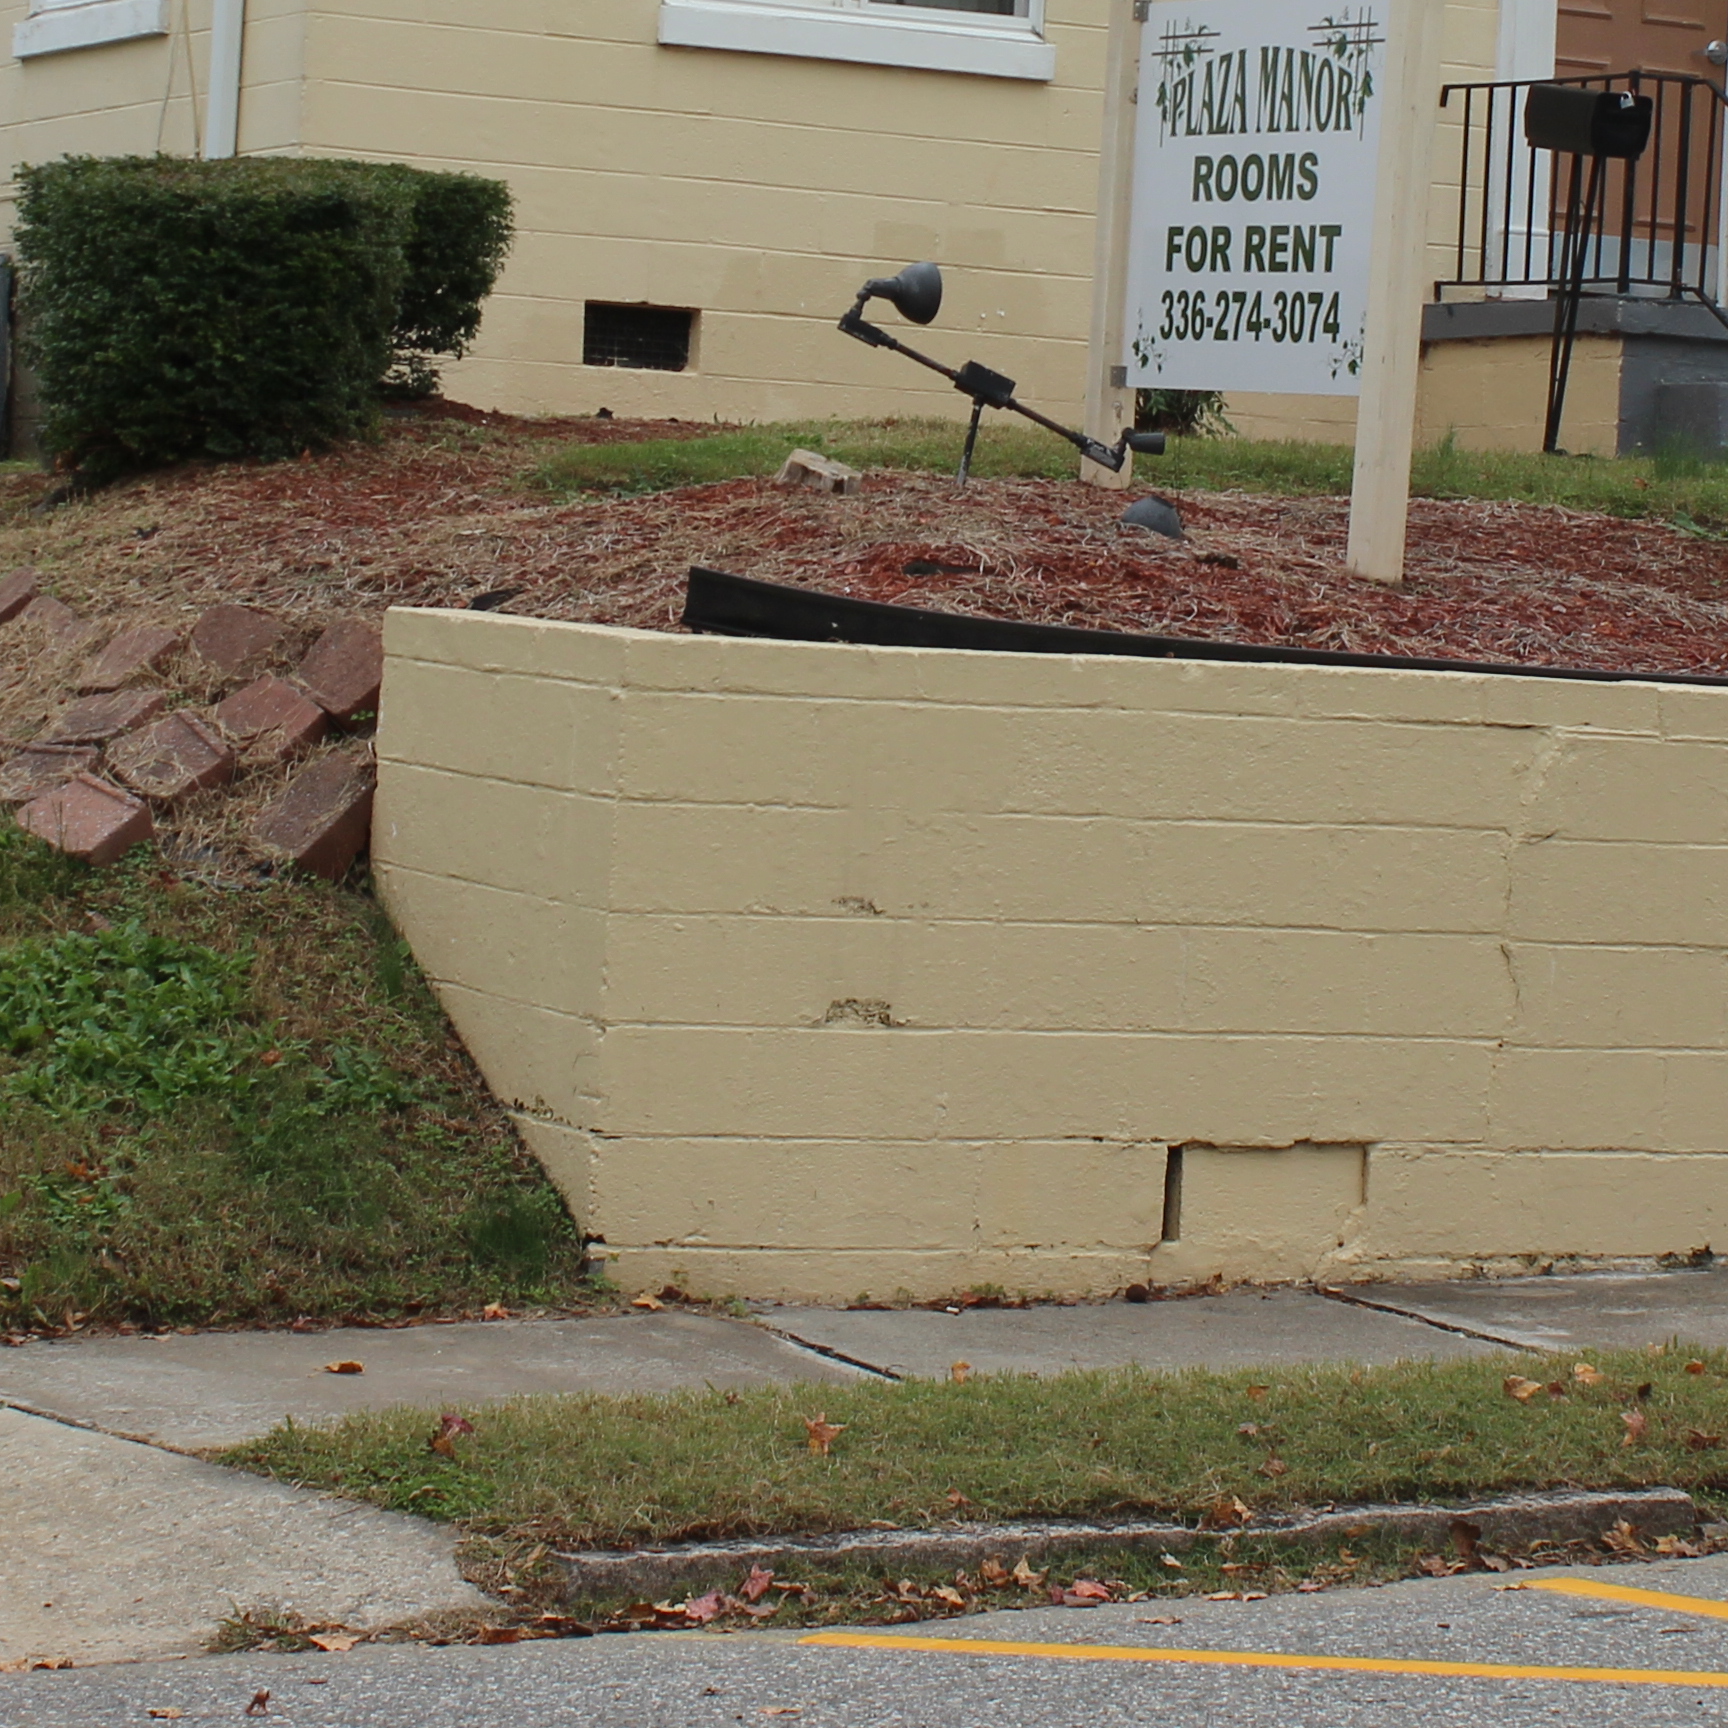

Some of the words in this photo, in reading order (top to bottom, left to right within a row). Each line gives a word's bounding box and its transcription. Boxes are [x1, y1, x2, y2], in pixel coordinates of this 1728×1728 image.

[1169, 48, 1247, 137] PLAZA
[1255, 45, 1353, 134] MANOR
[1191, 151, 1319, 203] ROOMS
[1165, 225, 1232, 273] FOR
[1243, 224, 1343, 273] RENT
[1159, 289, 1341, 345] 336-274-3074
